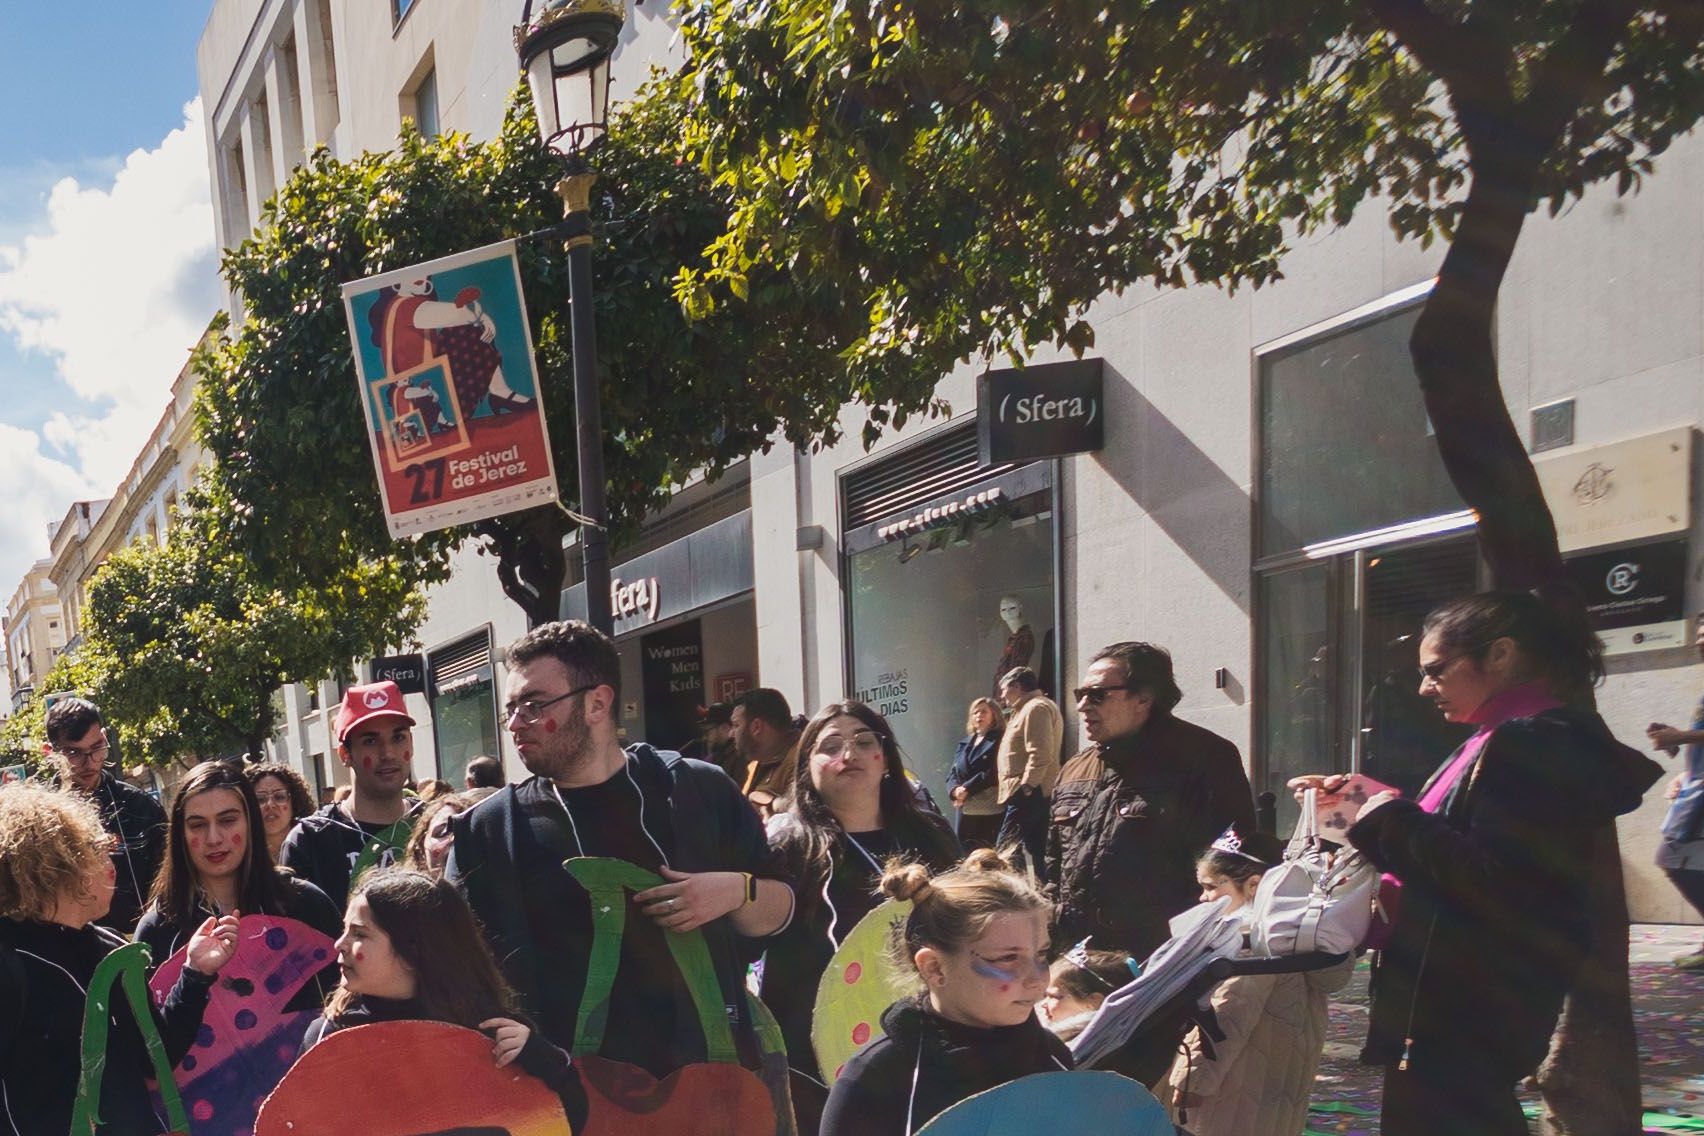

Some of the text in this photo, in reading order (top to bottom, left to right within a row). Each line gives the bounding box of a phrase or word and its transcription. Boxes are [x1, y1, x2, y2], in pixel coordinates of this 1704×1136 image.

[449, 445, 519, 475] Festival
[405, 457, 445, 504] 27
[452, 460, 527, 490] de Jerez
[647, 644, 699, 660] Women
[671, 661, 700, 674] Men
[669, 676, 701, 693] Kids
